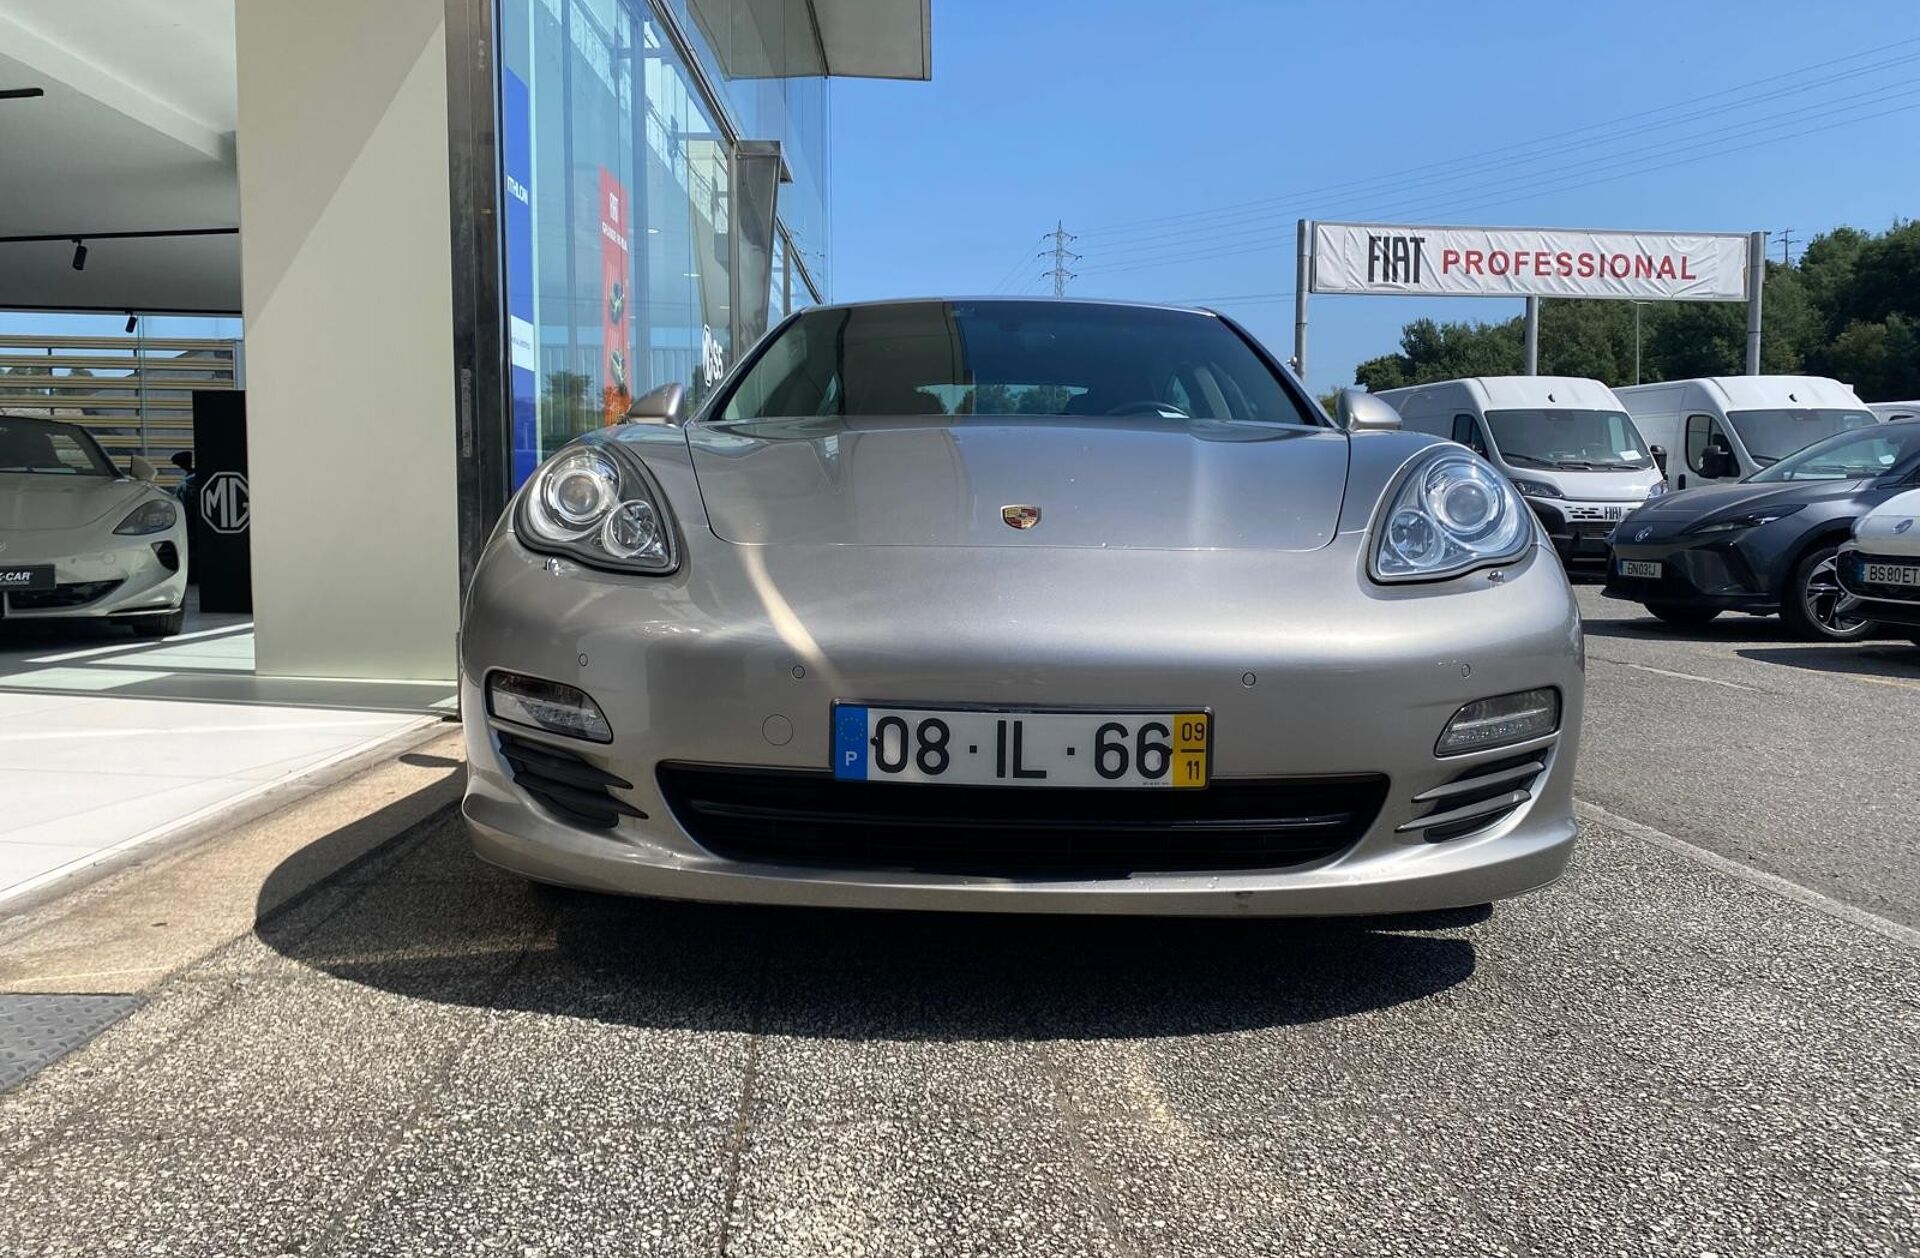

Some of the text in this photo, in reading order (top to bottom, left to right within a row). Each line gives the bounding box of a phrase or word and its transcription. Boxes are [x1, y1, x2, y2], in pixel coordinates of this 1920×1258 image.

[1367, 235, 1698, 284] FIAT PROFESSIONAL
[203, 475, 249, 530] MG
[1869, 565, 1919, 584] BS80ET
[1181, 722, 1204, 742] 09
[845, 751, 858, 766] P
[1186, 760, 1200, 780] 11
